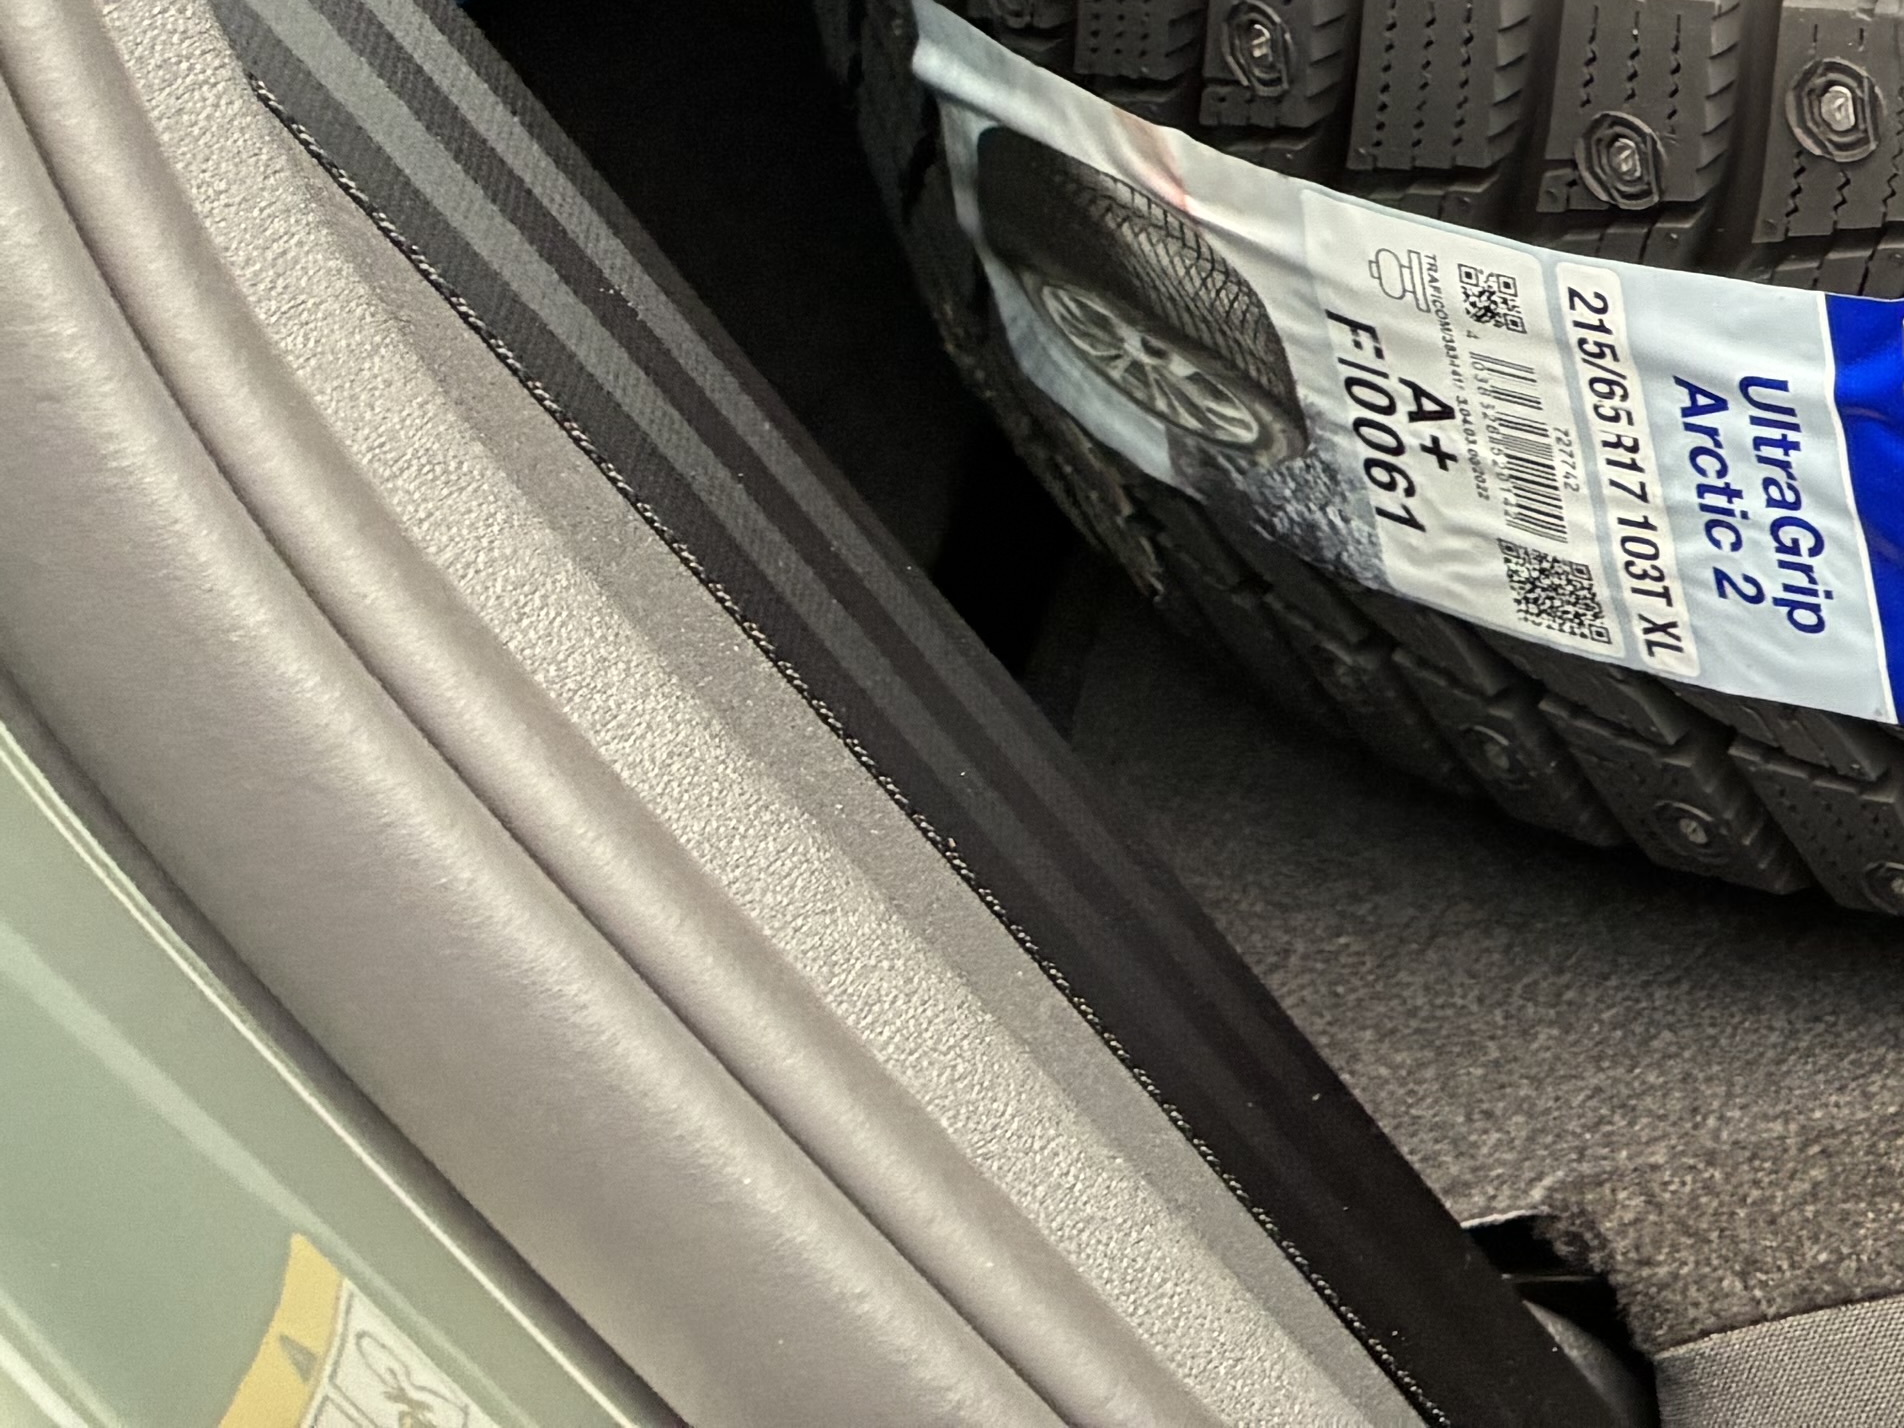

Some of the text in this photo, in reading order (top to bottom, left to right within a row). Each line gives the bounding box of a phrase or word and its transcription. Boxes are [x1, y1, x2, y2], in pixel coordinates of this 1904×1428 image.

[1398, 376, 1459, 472] A+
[1552, 426, 1580, 493] 727742
[1567, 285, 1684, 658] 215/65 R17 103T XL
[1672, 375, 1766, 605] Arctic 2
[1738, 375, 1834, 634] UltraGrip
